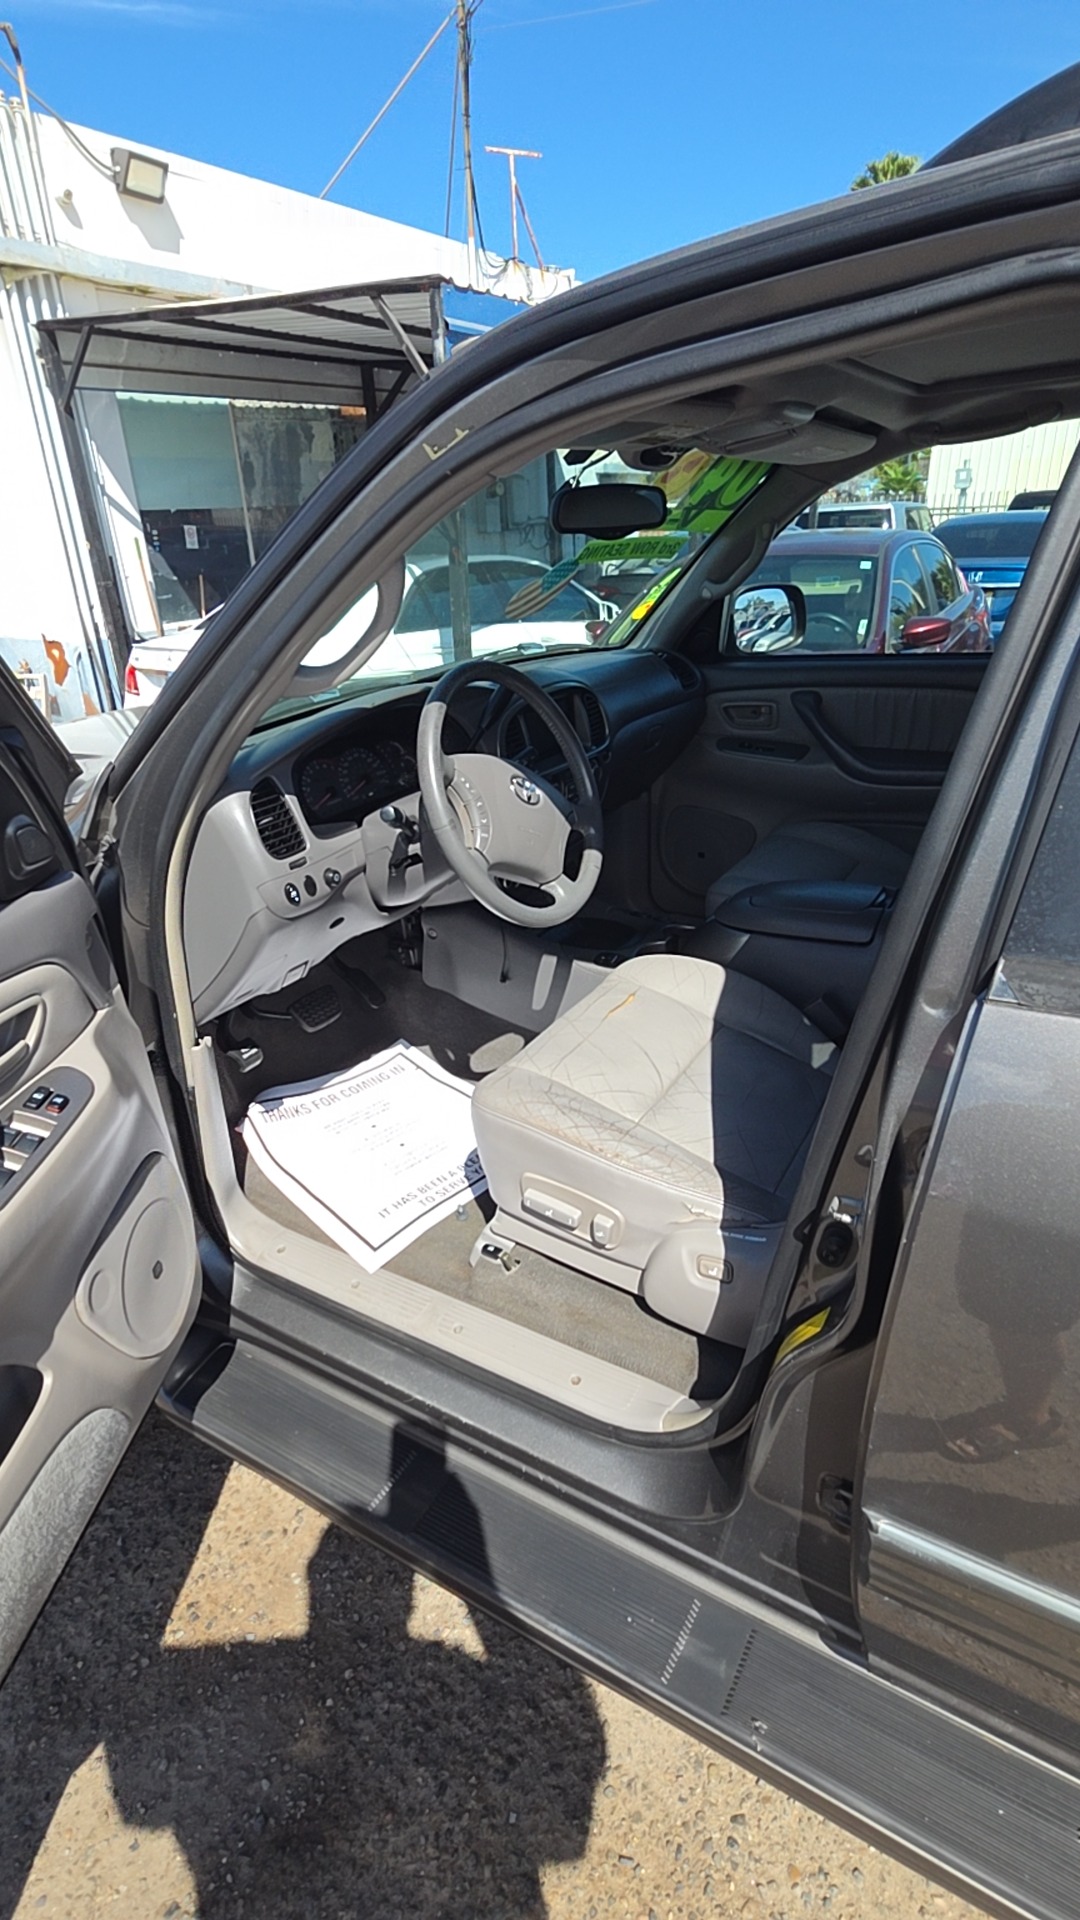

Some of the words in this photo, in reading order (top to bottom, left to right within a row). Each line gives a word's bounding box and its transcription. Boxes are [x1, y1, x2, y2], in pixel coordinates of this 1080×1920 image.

[258, 1103, 312, 1124] THANKS
[311, 1093, 341, 1111] FOR
[339, 1071, 391, 1099] COMING
[389, 1063, 406, 1076] IN
[378, 1207, 391, 1219] IT
[391, 1192, 418, 1210] HAS
[417, 1174, 448, 1195] BEEN
[448, 1169, 458, 1178] A
[418, 1195, 436, 1207] TO
